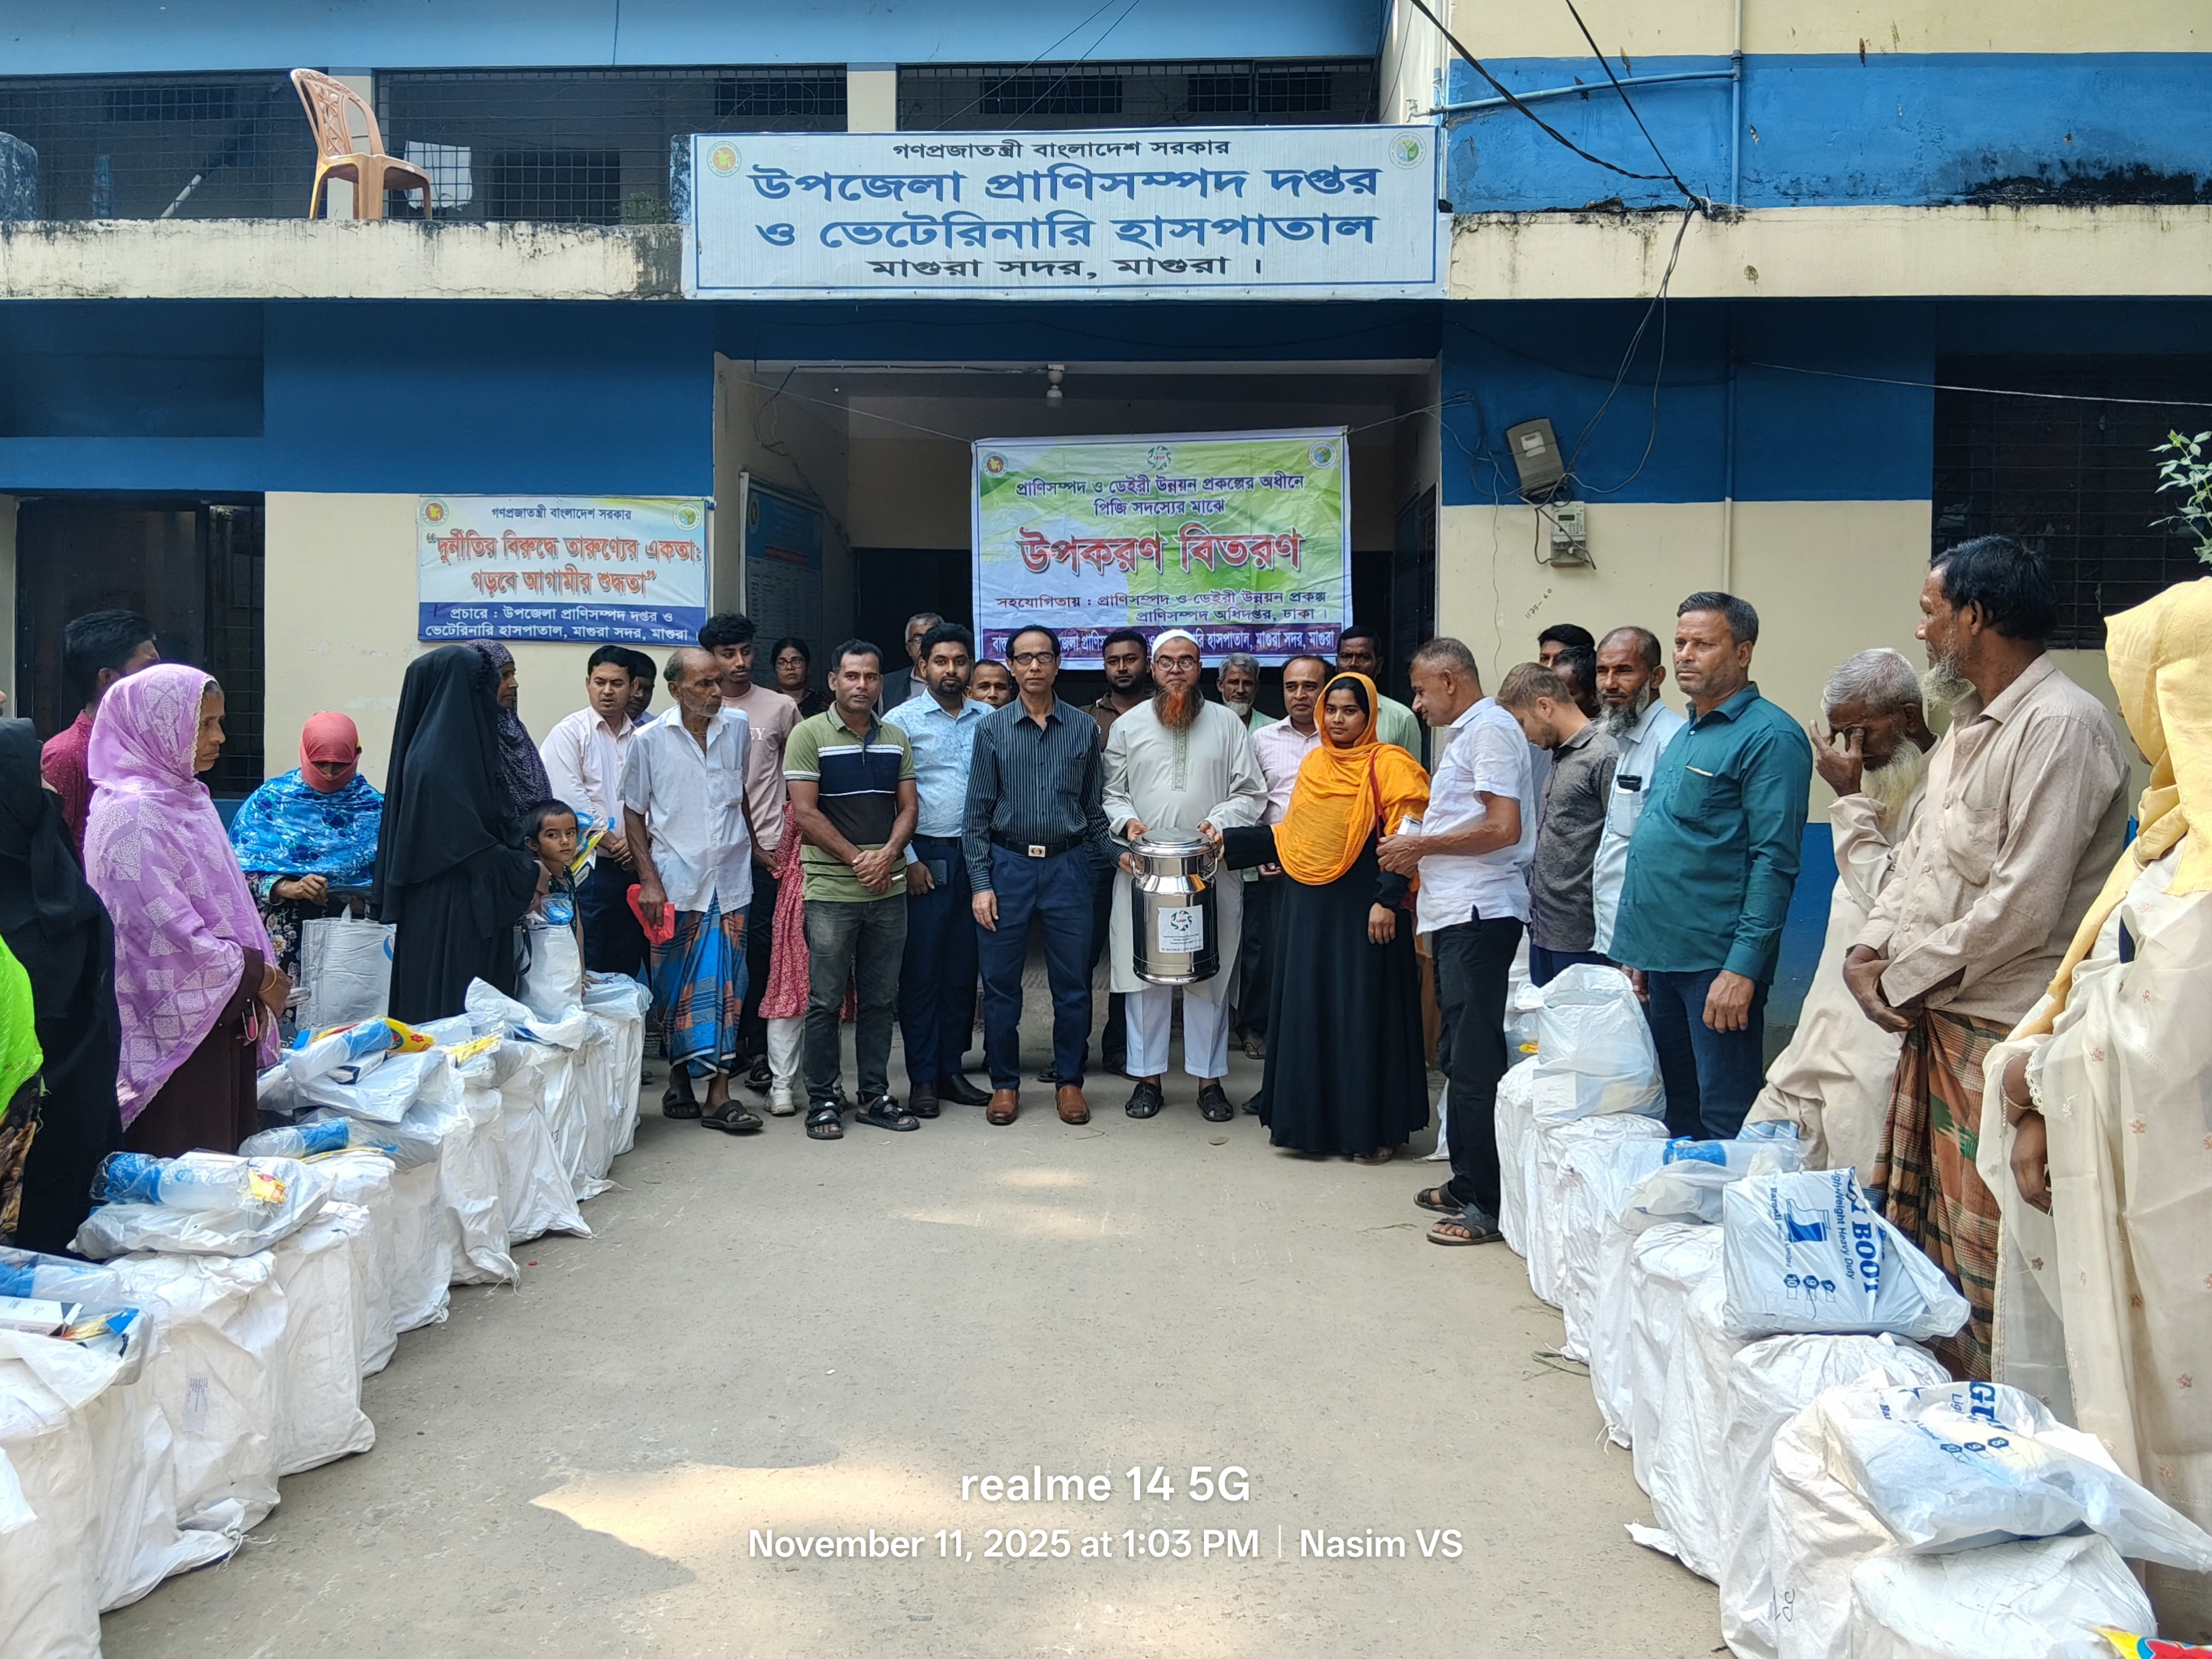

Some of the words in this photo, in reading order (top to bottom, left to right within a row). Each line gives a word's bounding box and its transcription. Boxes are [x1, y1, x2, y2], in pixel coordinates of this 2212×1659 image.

[1031, 141, 1141, 159] বাংলাদেশ
[1149, 140, 1231, 155] সরকার
[748, 165, 967, 202] উপজেলা
[985, 163, 1249, 202] প্রাণিসম্পদ
[1263, 165, 1382, 197] দপ্তর
[756, 224, 795, 246] ও
[821, 210, 1095, 249] ভেটেরিনারি
[1110, 213, 1380, 250] হাসপাতাল
[867, 259, 983, 277] মাগুরা
[995, 261, 1096, 279] সদর,
[1112, 256, 1231, 275] মাগুরা
[1016, 477, 1087, 497] প্রাণিসম্পদ
[1092, 481, 1103, 493] ও
[1109, 474, 1151, 495] ডেইরী
[1155, 474, 1197, 494] উন্নয়ন
[1202, 476, 1255, 492] প্রকল্পের
[1258, 470, 1305, 490] অধীনে
[550, 507, 596, 520] বাংলাদেশ
[598, 508, 633, 522] সরকার
[1093, 497, 1129, 516] পিজি
[1131, 500, 1186, 516] সদস্যের
[1190, 498, 1226, 515] মাঝে
[501, 529, 560, 561] বিরুদ্ধে
[563, 533, 639, 563] তারুণ্যের
[1015, 527, 1166, 576] উপকরণ
[1175, 521, 1307, 574] বিতরণ
[471, 568, 519, 598] গড়বে
[522, 563, 593, 596] আগামীর
[995, 594, 1081, 609] সহযোগিতায়
[1098, 592, 1170, 607] প্রাণিসম্পদ
[1176, 595, 1188, 604] ও
[1194, 589, 1237, 605] ডেইরী
[1241, 589, 1284, 605] উন্নয়ন
[1289, 591, 1327, 604] প্রকল্প
[450, 607, 489, 621] প্রচারে
[502, 605, 558, 621] উপজেলা
[561, 605, 626, 622] প্রাণিসম্পদ
[629, 609, 659, 623] দপ্তর
[662, 613, 673, 622] ও
[1136, 607, 1209, 622] প্রাণিসম্পদ
[1282, 608, 1316, 620] ঢাকা
[425, 622, 494, 638] ভেটেরিনারি
[498, 624, 568, 639] হাসপাতাল,
[571, 625, 610, 639] মাগুরা
[613, 626, 647, 642] সদর,
[650, 627, 689, 641] মাগুরা
[1256, 631, 1281, 649] মাগুরা
[1308, 630, 1335, 648] মাগুরা
[1837, 1228, 1851, 1255] Heavy
[1844, 1258, 1855, 1280] Duty
